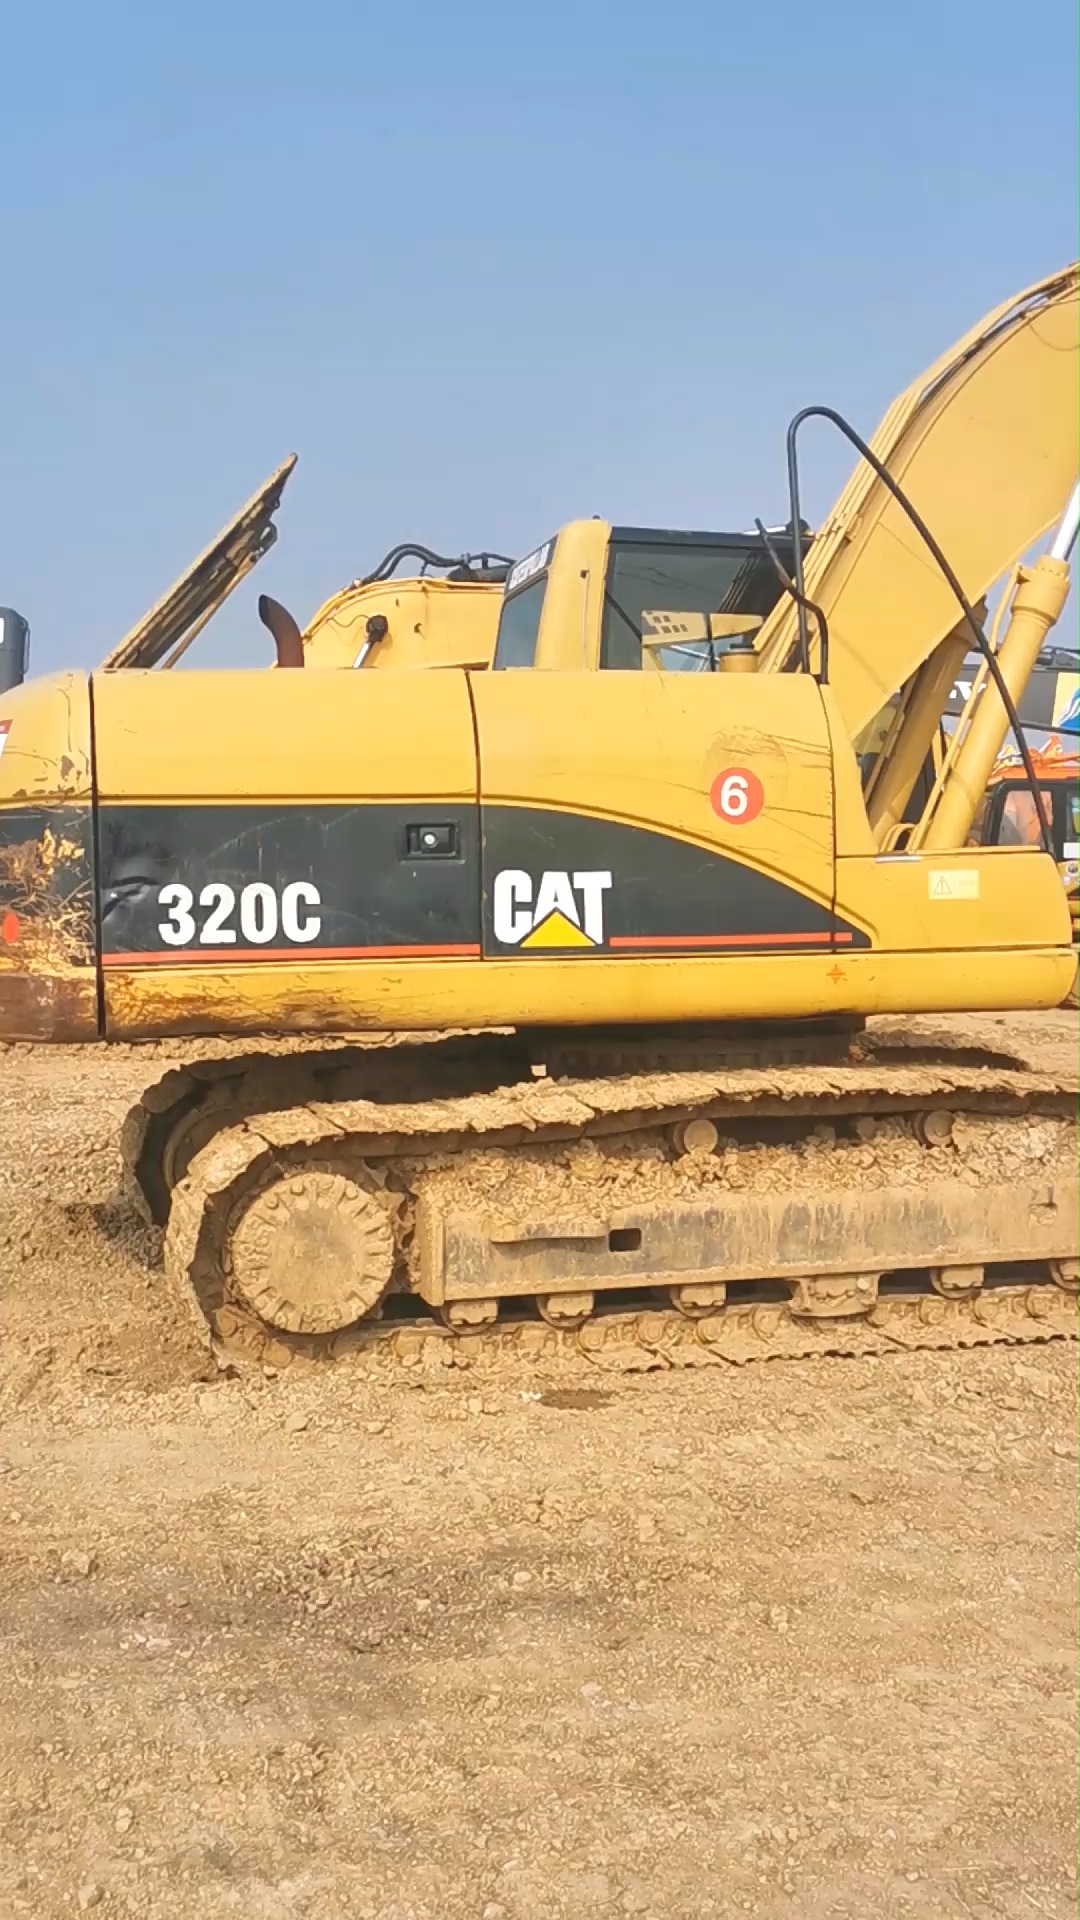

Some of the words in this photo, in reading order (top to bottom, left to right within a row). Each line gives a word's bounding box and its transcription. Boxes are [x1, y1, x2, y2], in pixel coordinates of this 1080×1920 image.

[720, 775, 748, 816] 6
[158, 881, 321, 945] 320C
[493, 869, 612, 945] CAT
